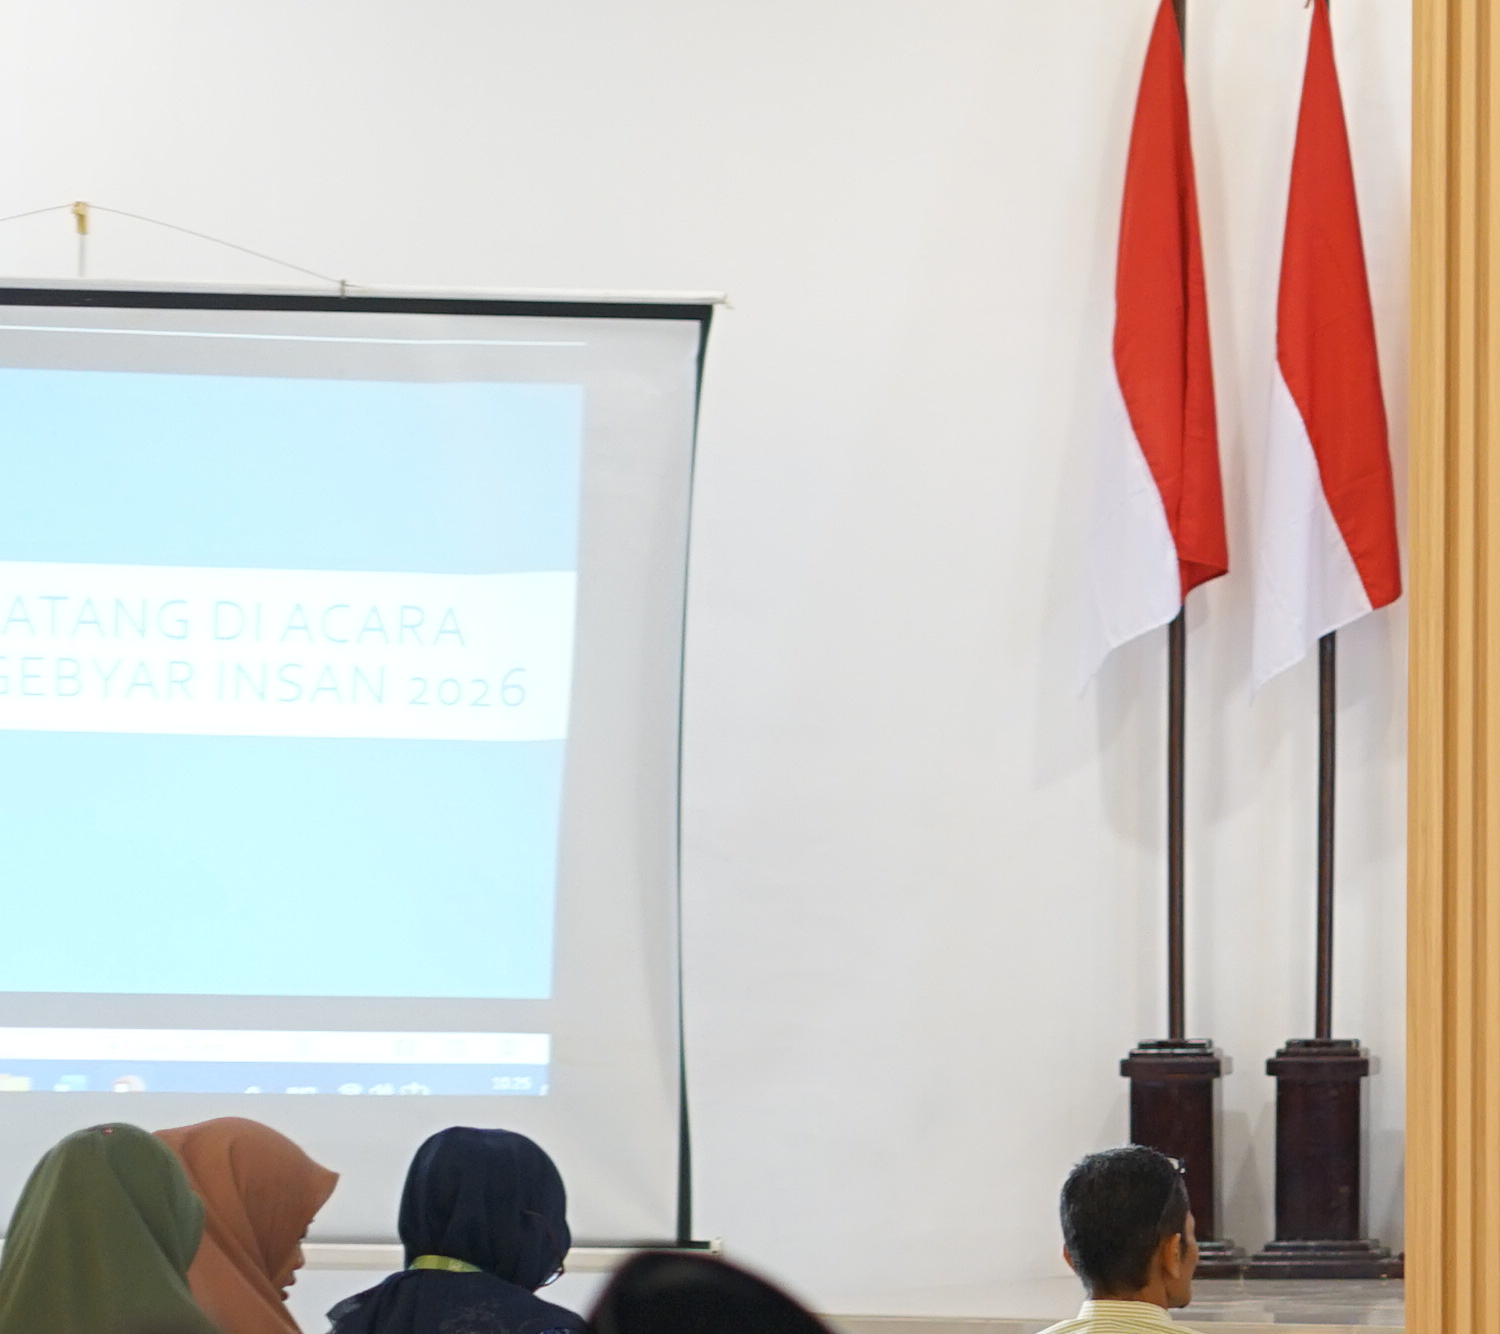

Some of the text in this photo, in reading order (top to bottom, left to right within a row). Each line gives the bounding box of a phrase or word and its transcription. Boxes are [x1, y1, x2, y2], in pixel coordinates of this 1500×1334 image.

[213, 599, 263, 642] DI
[280, 603, 467, 647] ACARA
[217, 662, 386, 705] INSAN
[407, 666, 528, 708] 2026
